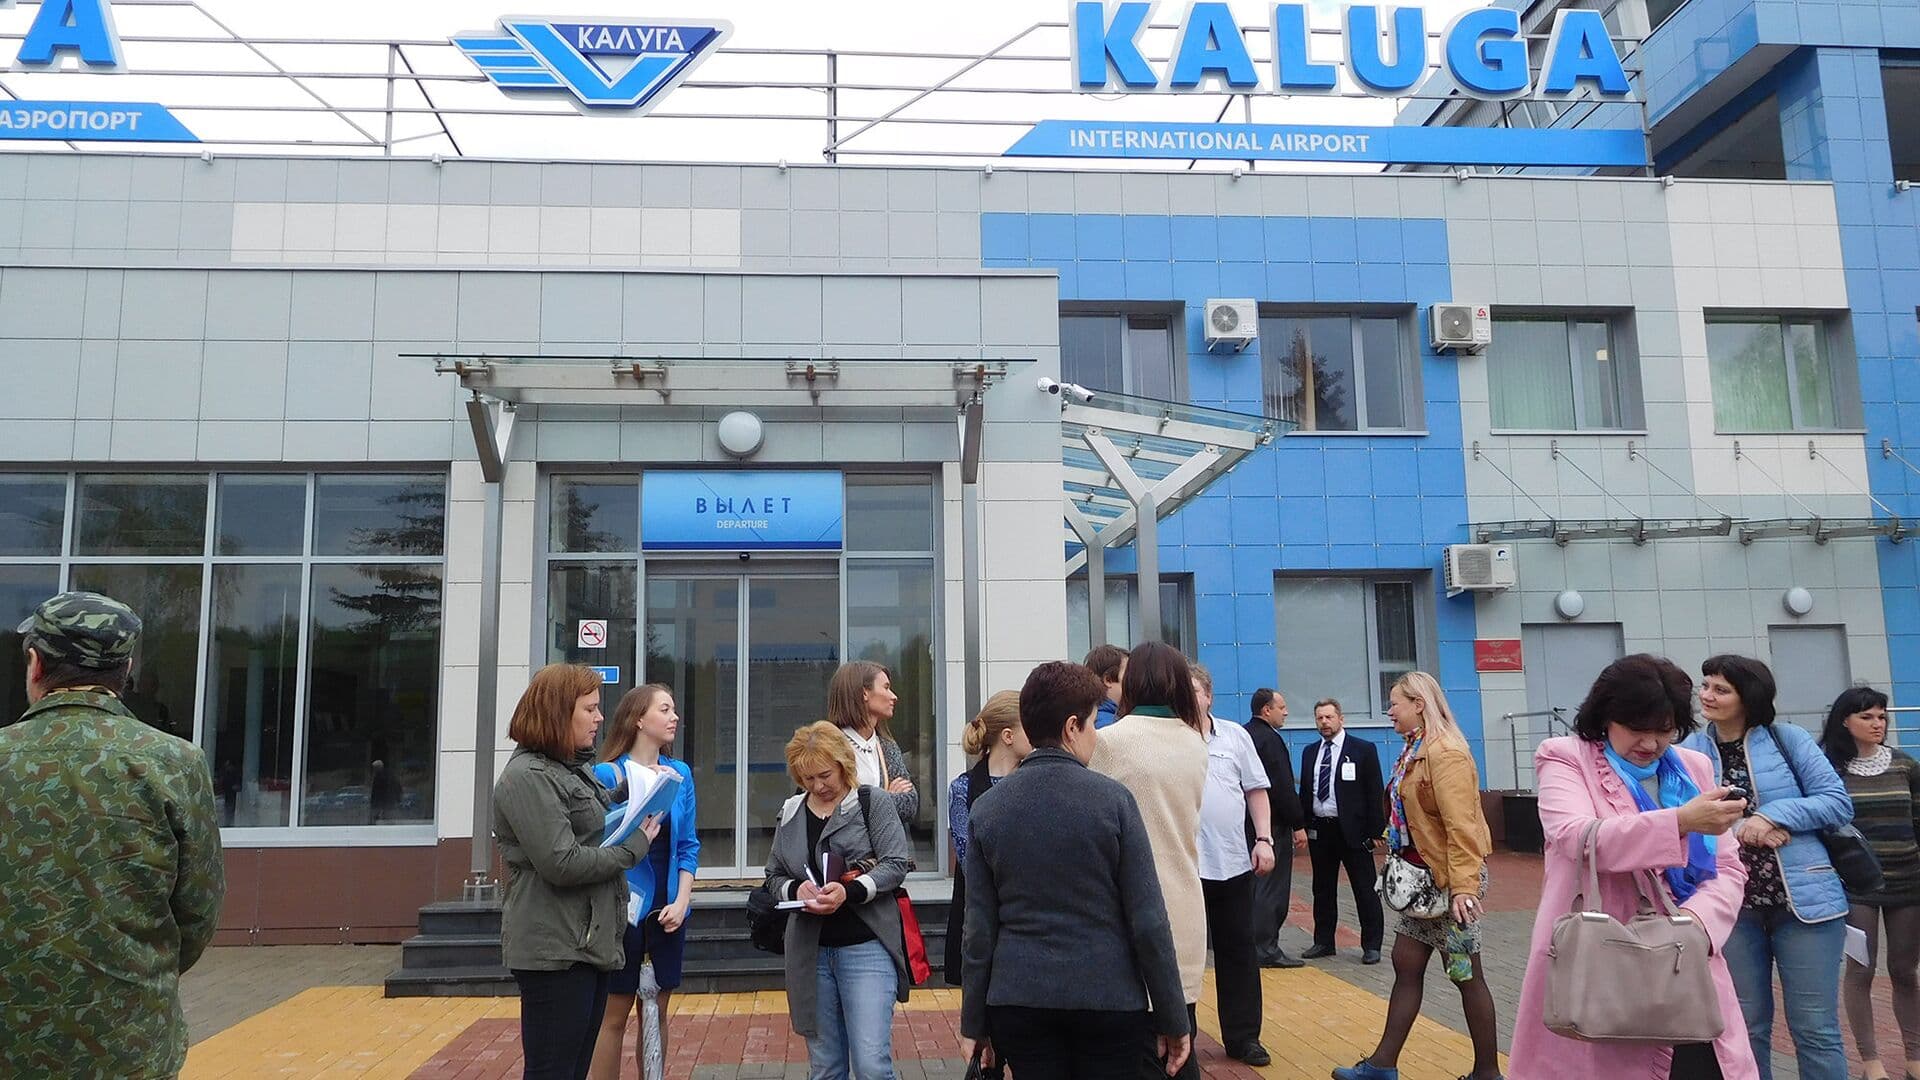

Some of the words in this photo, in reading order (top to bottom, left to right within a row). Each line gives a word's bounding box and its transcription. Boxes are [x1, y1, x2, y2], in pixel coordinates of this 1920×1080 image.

[578, 26, 685, 51] КАЛУГА
[1075, 1, 1632, 96] KALUGA
[0, 109, 142, 131] АЭРОПОРТ
[1069, 129, 1262, 151] INTERNATIONAL
[1269, 132, 1370, 153] AIRPORT
[696, 497, 791, 514] ВЫЛЕТ
[716, 520, 768, 529] DEPARTURE
